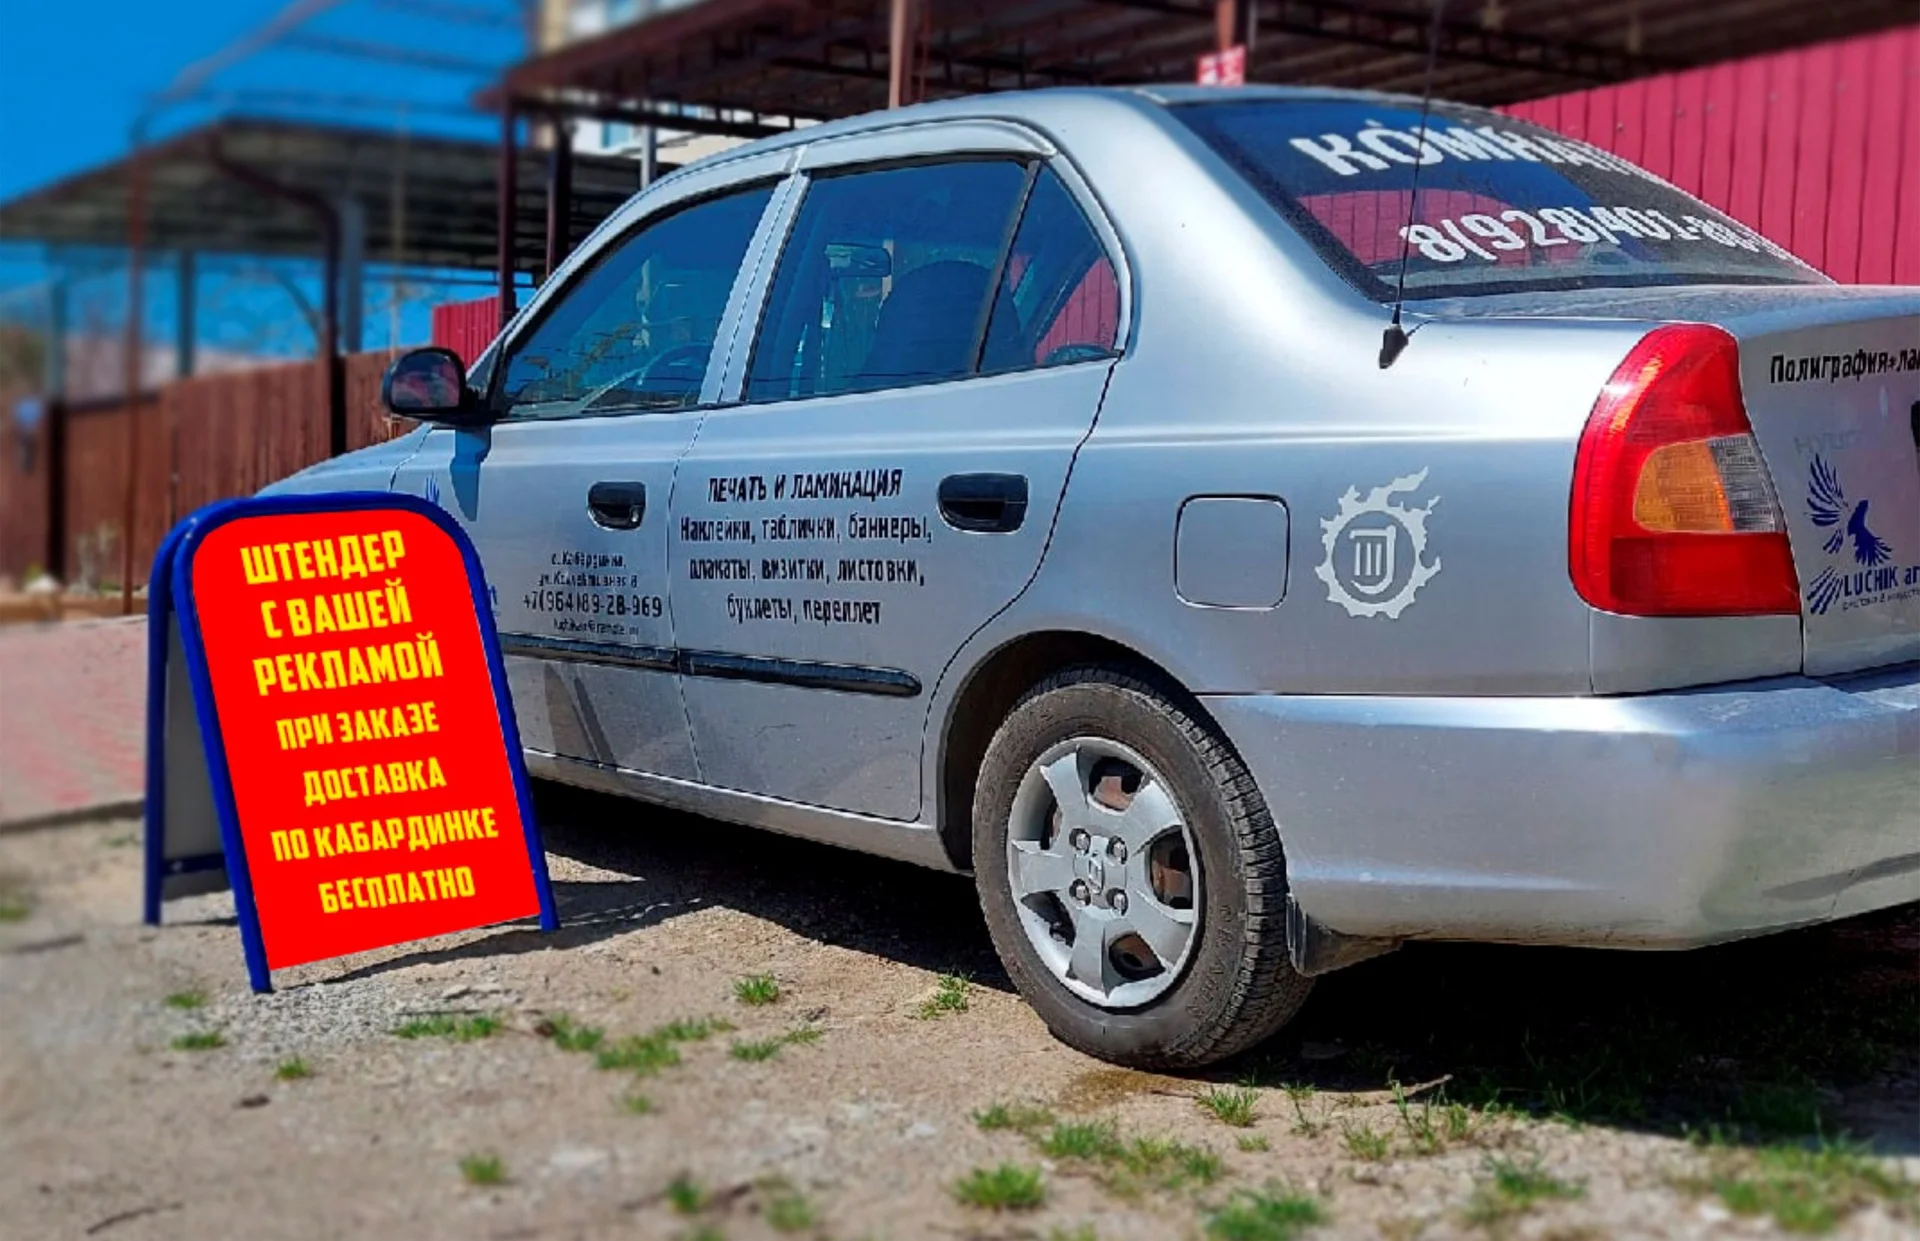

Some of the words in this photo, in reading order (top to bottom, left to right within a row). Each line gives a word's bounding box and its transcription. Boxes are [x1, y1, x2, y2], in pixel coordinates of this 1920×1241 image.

[708, 475, 767, 502] ПЕЧАТЬ
[774, 473, 787, 500] И
[790, 468, 903, 502] ЛАМИНАЦИЯ
[680, 515, 756, 544] Наклейки,
[761, 513, 840, 543] таблички,
[848, 511, 932, 544] баннеры,
[240, 530, 406, 585] ШТЕНДЕР
[689, 558, 756, 585] плакаты,
[761, 558, 829, 586] визитки,
[837, 558, 925, 587] листовки,
[1844, 566, 1898, 597] LUCHIK
[260, 600, 283, 638] С
[286, 577, 412, 637] ВАШЕЙ
[727, 592, 798, 625] буклеты,
[803, 599, 881, 627] переплет
[252, 631, 444, 696] РЕКЛАМОЙ
[276, 712, 334, 750] ПРИ
[336, 701, 440, 743] ЗАКАЗЕ
[303, 757, 447, 807] ДОСТАВКА
[271, 828, 310, 861] ПО
[313, 807, 499, 858] КАБАРДИНКЕ
[318, 866, 476, 913] БЕСПЛАТНО
